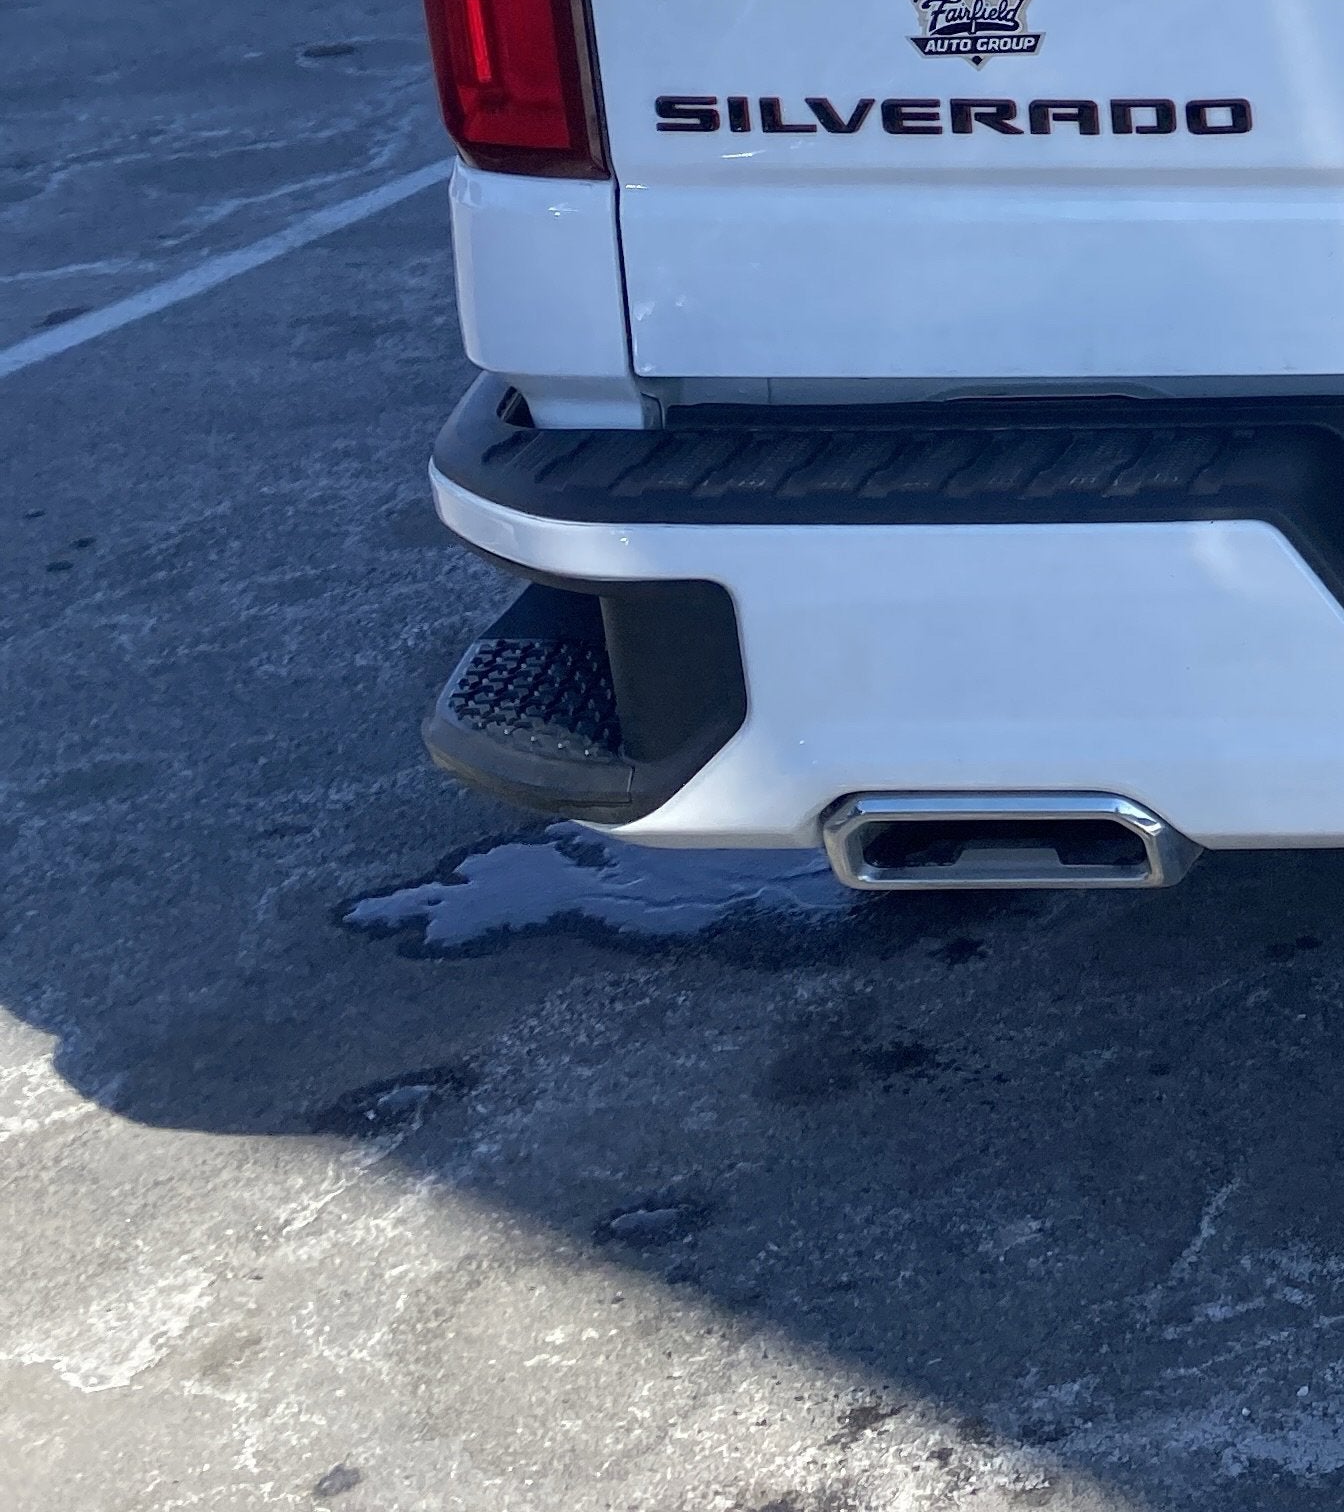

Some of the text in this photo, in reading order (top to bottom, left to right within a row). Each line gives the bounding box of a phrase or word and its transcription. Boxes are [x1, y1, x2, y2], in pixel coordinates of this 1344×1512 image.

[925, 37, 1037, 53] AUTO GROUP
[654, 95, 1253, 135] SILVERADO
